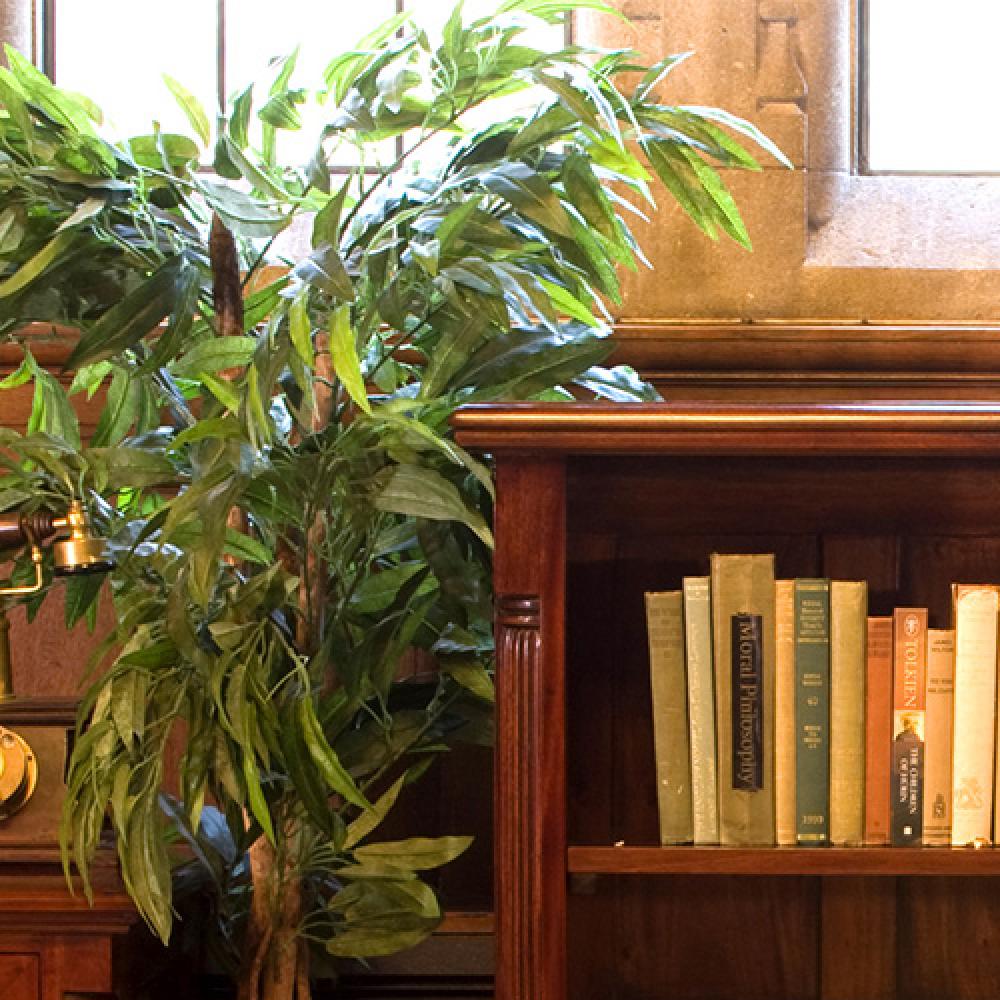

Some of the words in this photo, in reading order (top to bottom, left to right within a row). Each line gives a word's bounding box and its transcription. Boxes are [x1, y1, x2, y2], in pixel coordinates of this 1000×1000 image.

[738, 623, 757, 678] Moral
[903, 640, 918, 707] TOLKIEN
[737, 684, 758, 786] Philosophy
